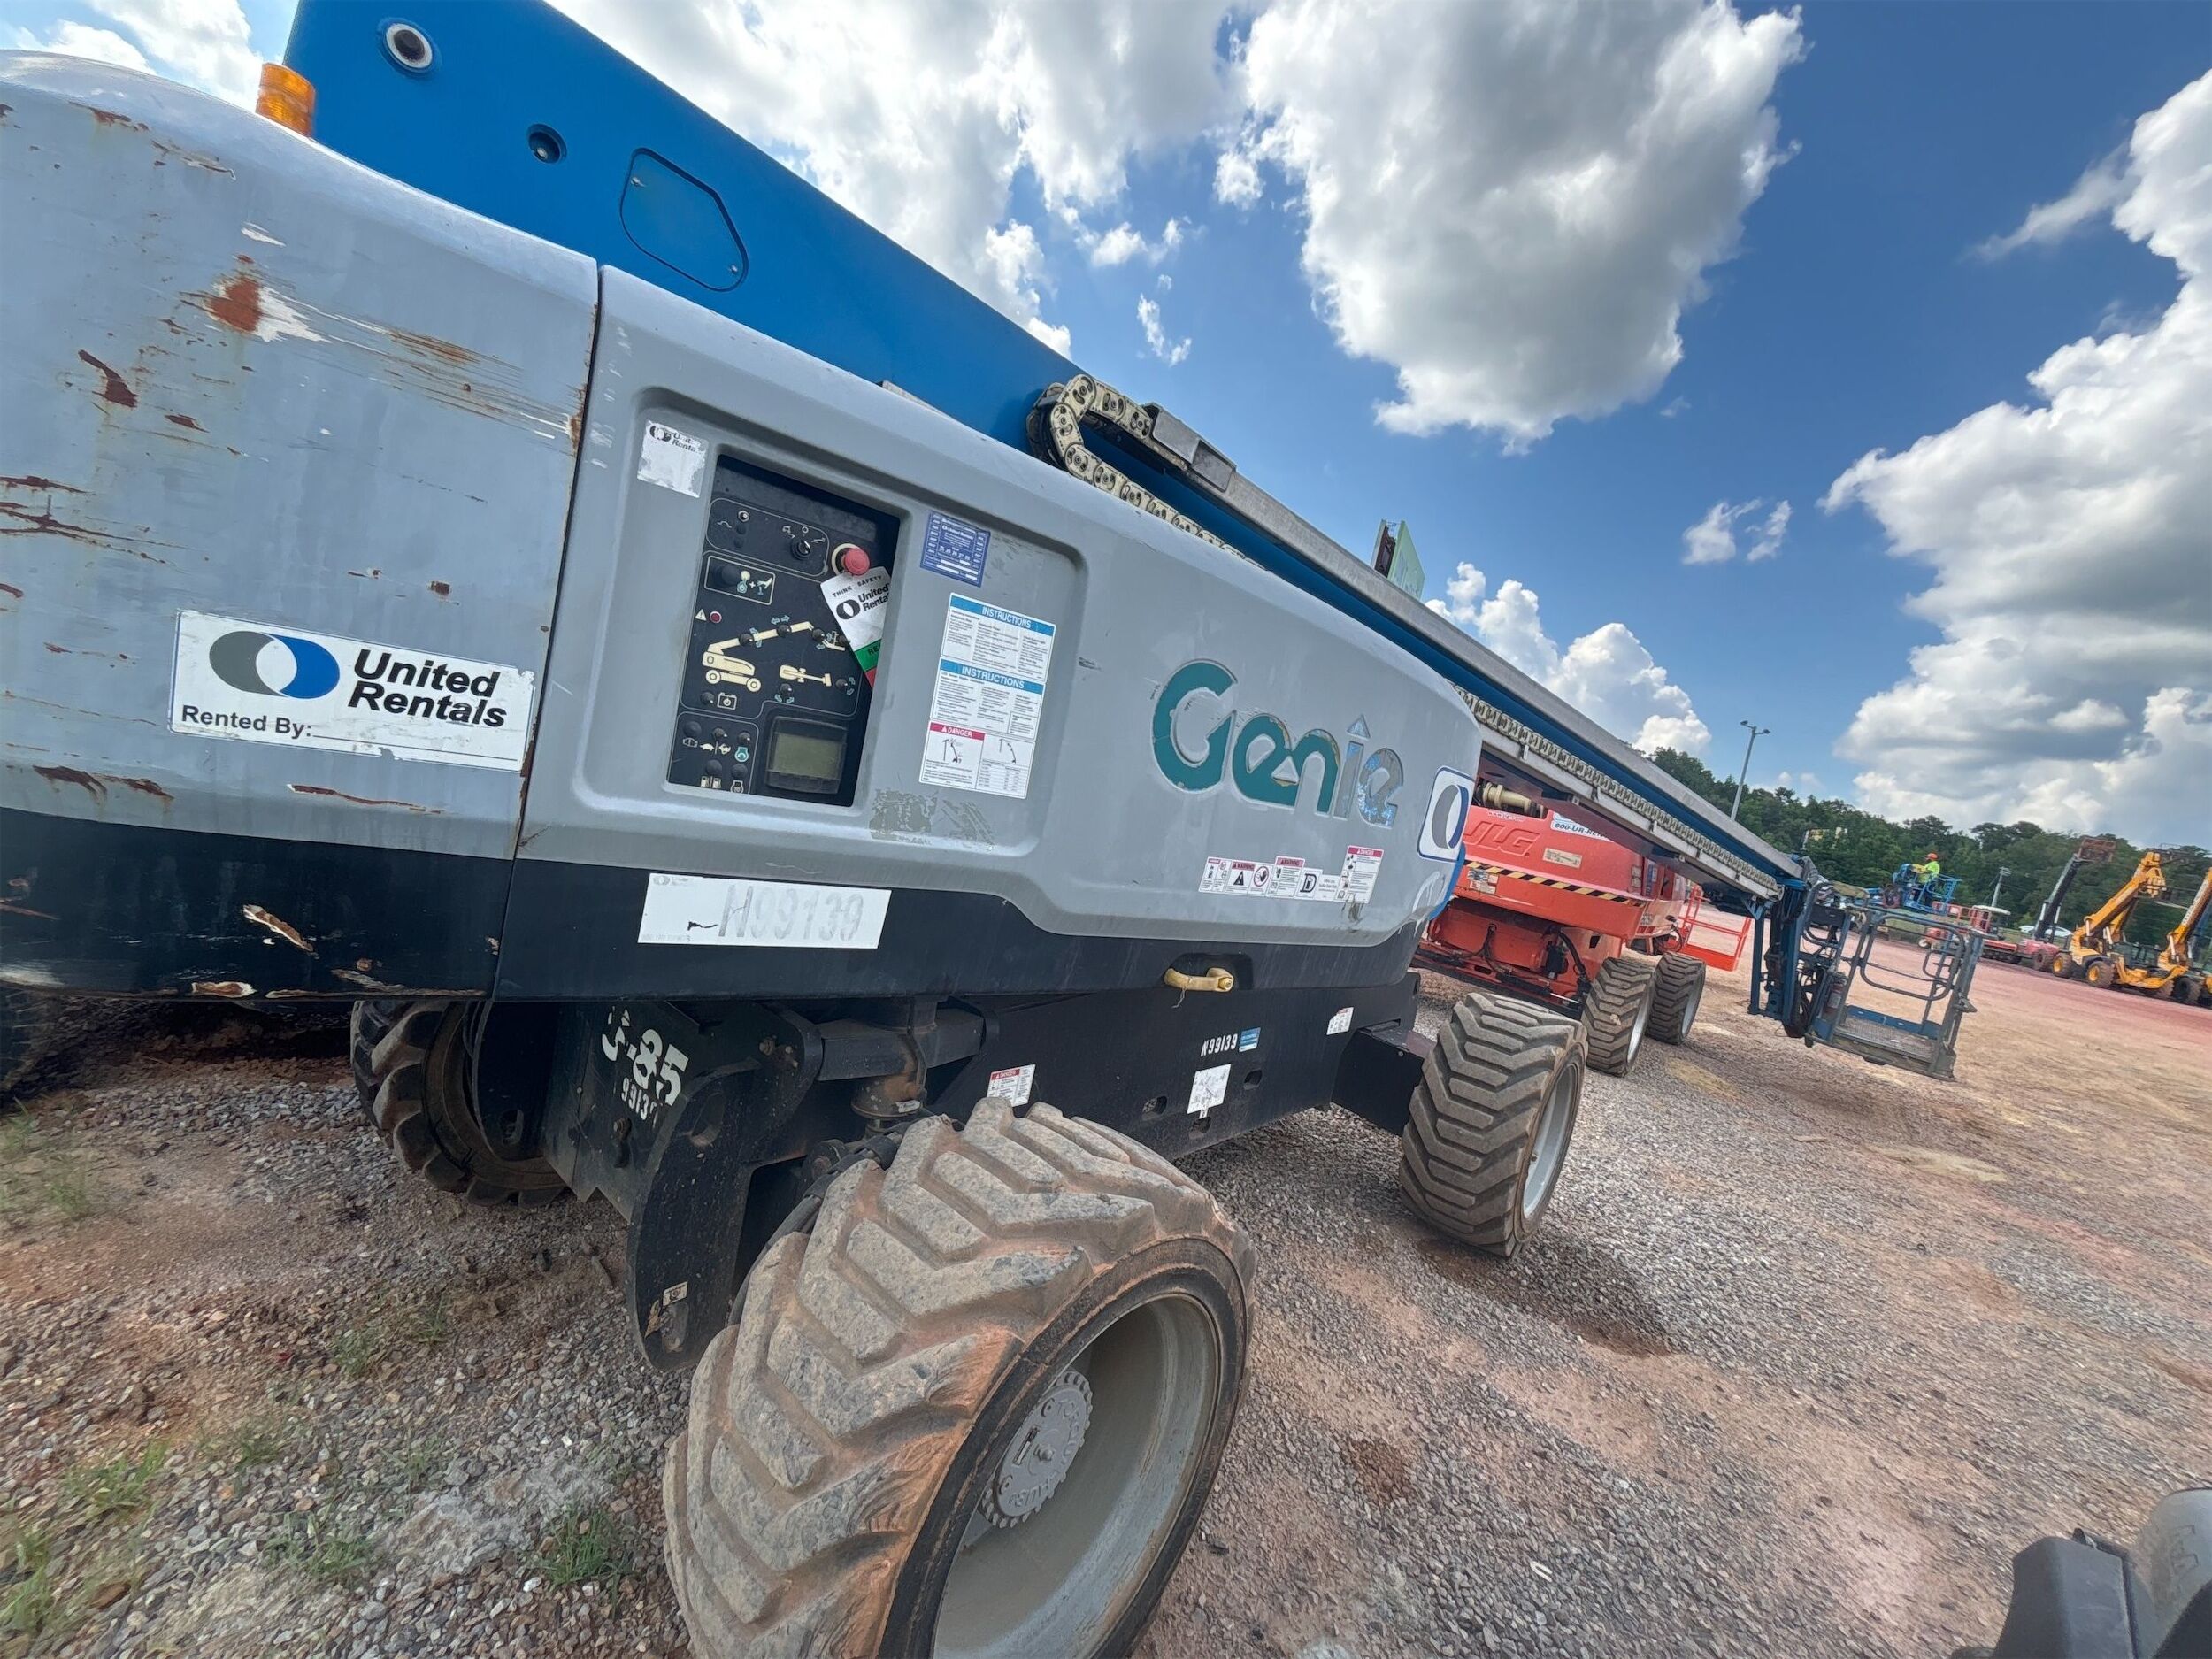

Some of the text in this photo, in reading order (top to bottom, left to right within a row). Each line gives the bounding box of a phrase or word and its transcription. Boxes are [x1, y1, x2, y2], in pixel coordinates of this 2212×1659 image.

[833, 575, 882, 598] THINK SAFETY
[858, 584, 889, 603] United
[863, 593, 889, 611] Renta
[981, 606, 1032, 628] INSTRUCTIONS
[354, 649, 501, 698] United
[962, 666, 1025, 689] INSTRUCTIONS
[348, 681, 507, 727] Rentals
[181, 705, 312, 740] Rented By:
[948, 726, 973, 738] DANGER
[1152, 659, 1405, 830] Genie
[1463, 821, 1540, 856] JLG
[1200, 1033, 1239, 1057] N99139
